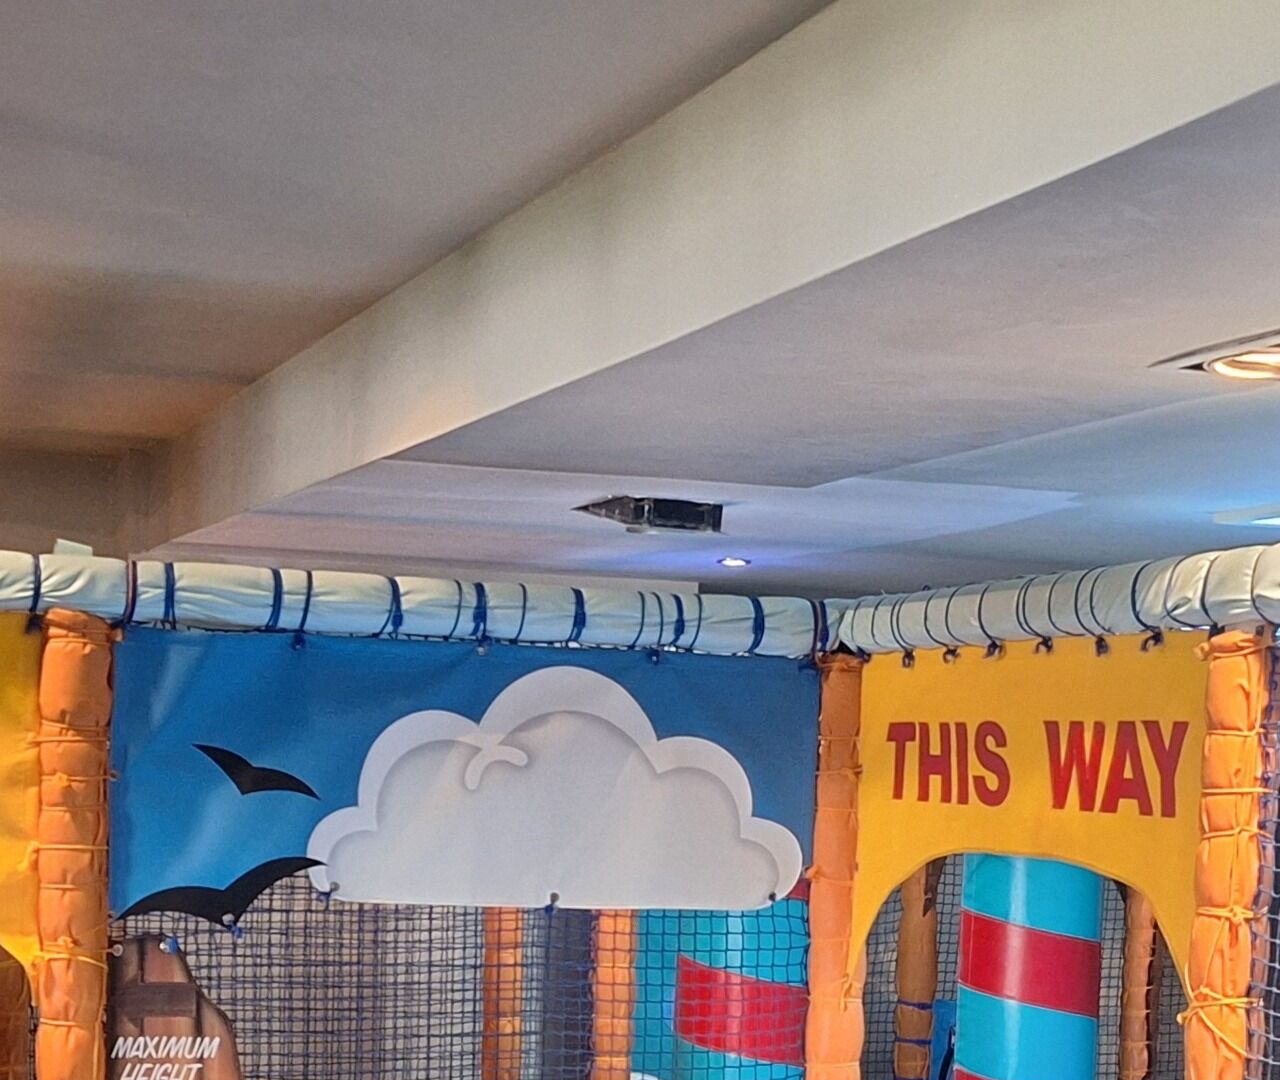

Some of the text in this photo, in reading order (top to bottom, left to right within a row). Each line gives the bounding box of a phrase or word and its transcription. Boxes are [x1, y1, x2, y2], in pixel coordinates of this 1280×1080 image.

[886, 719, 1189, 818] THIS WAY
[110, 1035, 220, 1059] MAXIMUM
